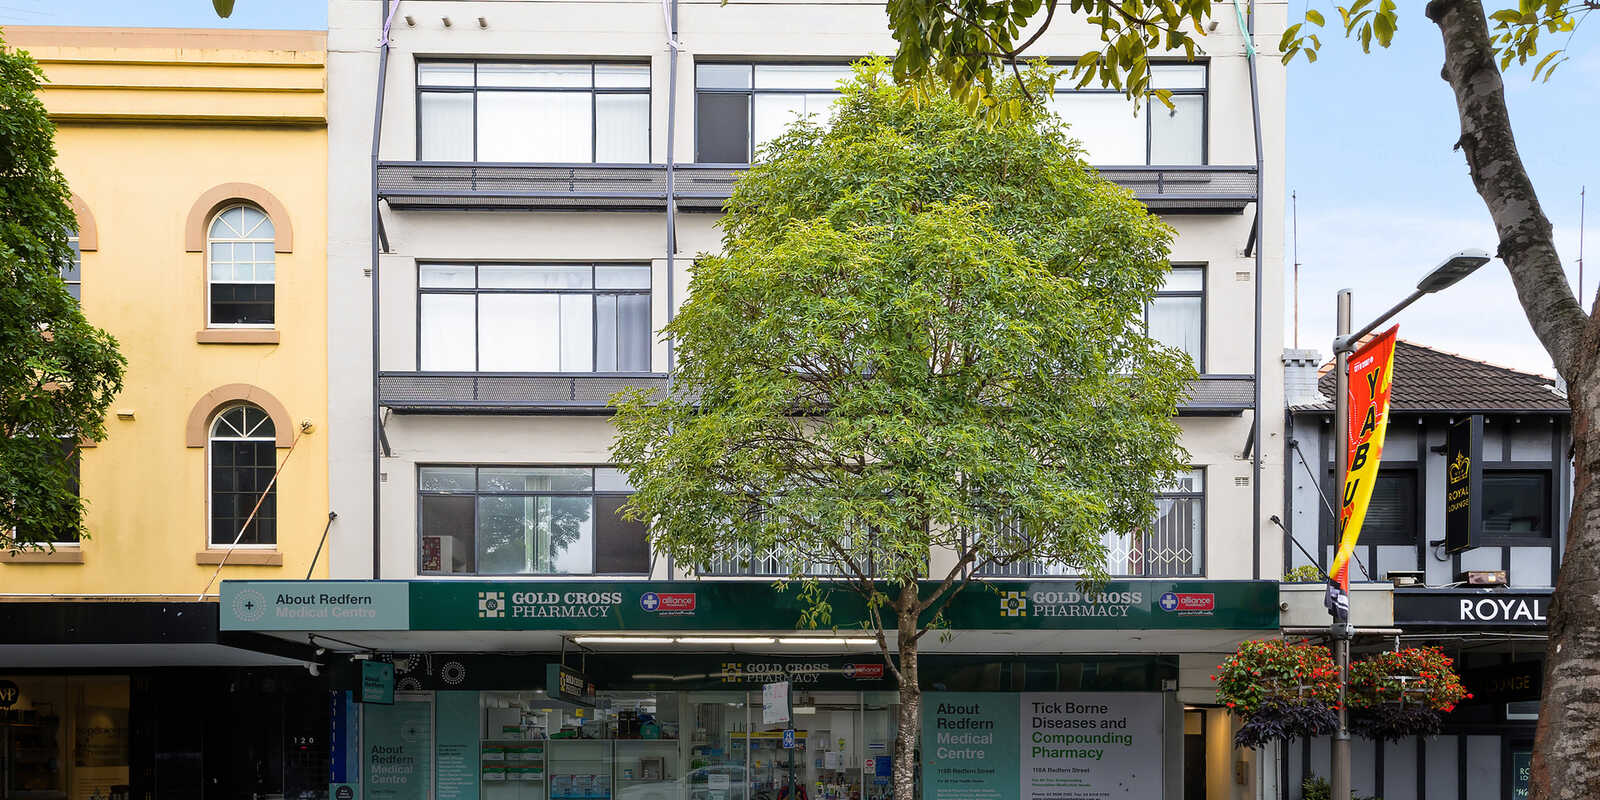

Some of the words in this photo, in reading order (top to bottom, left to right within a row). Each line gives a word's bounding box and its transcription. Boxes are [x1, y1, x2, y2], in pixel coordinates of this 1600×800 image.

[1448, 487, 1469, 501] ROYAL
[1448, 498, 1469, 512] LOUNGE
[276, 594, 316, 605] About
[319, 594, 372, 605] Redfern
[512, 592, 560, 604] GOLD
[563, 592, 622, 604] CROSS
[1033, 592, 1082, 604] GOLD
[1085, 592, 1143, 604] CROSS
[276, 607, 328, 618] Medical
[332, 607, 376, 618] Centre
[512, 606, 610, 617] PHARMACY
[1033, 605, 1129, 617] PHARMACY
[1460, 599, 1547, 621] ROYAL
[747, 663, 783, 673] GOLD
[785, 663, 830, 673] CROSS
[937, 703, 980, 714] About
[1032, 702, 1062, 714] Tick
[1065, 702, 1108, 714] Borne
[937, 718, 994, 729] Redfern
[1032, 717, 1097, 729] Diseases
[1101, 717, 1127, 729] and
[937, 732, 993, 744] Medical
[1032, 731, 1132, 746] Compounding
[371, 745, 404, 754] About
[936, 747, 985, 759] Centre
[1032, 746, 1104, 760] Pharmacy
[371, 755, 414, 764] Redfern
[371, 775, 408, 784] Centre
